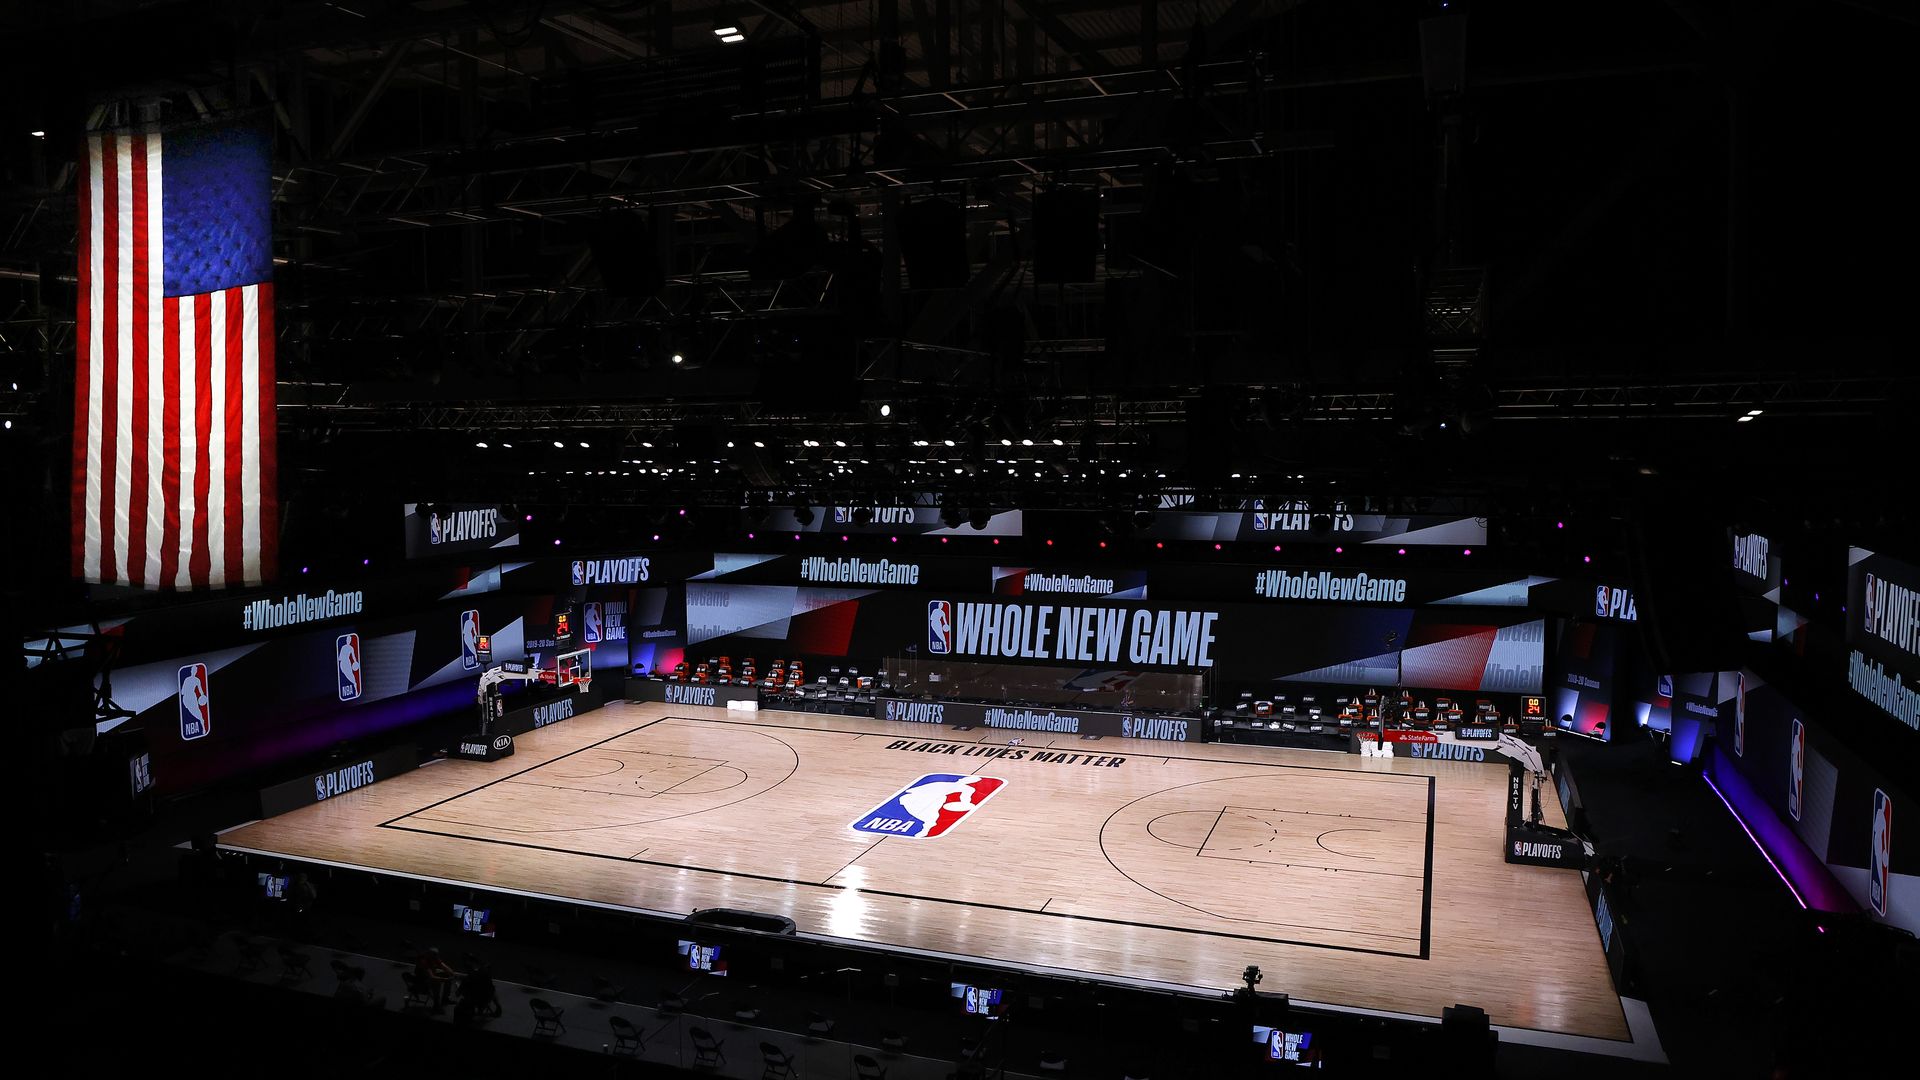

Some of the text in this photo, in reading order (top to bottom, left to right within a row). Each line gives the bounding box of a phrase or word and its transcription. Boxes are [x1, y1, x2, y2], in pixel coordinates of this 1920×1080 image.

[442, 508, 497, 542] PLAYOFFS
[585, 558, 650, 585] PLAYOFFS
[800, 556, 919, 585] #WholeNewGame
[1024, 573, 1113, 594] #WholeNewGame
[1255, 570, 1407, 603] #WholeNewGame
[243, 589, 363, 631] #WholeNewGame
[556, 622, 569, 635] 24
[605, 626, 626, 641] GAME
[957, 602, 1219, 667] WHOLE NEW GAME
[931, 640, 943, 651] NBA
[342, 684, 354, 697] NBA
[673, 686, 715, 705] PLAYOFFS
[540, 698, 574, 727] PLAYOFFS
[896, 702, 944, 725] PLAYOFFS
[1528, 706, 1540, 714] 24
[185, 721, 200, 736] NBA
[984, 707, 1079, 733] #WholeNewGame
[1133, 718, 1188, 742] PLAYOFFS
[1467, 728, 1492, 739] PLAYOFFS
[464, 743, 488, 756] PLAYOFFS
[496, 738, 508, 748] KIA
[1423, 742, 1485, 762] PLAYOFFS
[885, 740, 1127, 768] BLACK LIVES MATTER
[326, 760, 374, 797] PLAYOFFS
[1513, 797, 1519, 810] TV
[864, 816, 916, 833] NBA
[1522, 842, 1563, 859] PLAYOFFS
[1285, 1032, 1304, 1044] WHOLE
[1285, 1041, 1298, 1052] NEW
[1285, 1051, 1300, 1061] GAME
